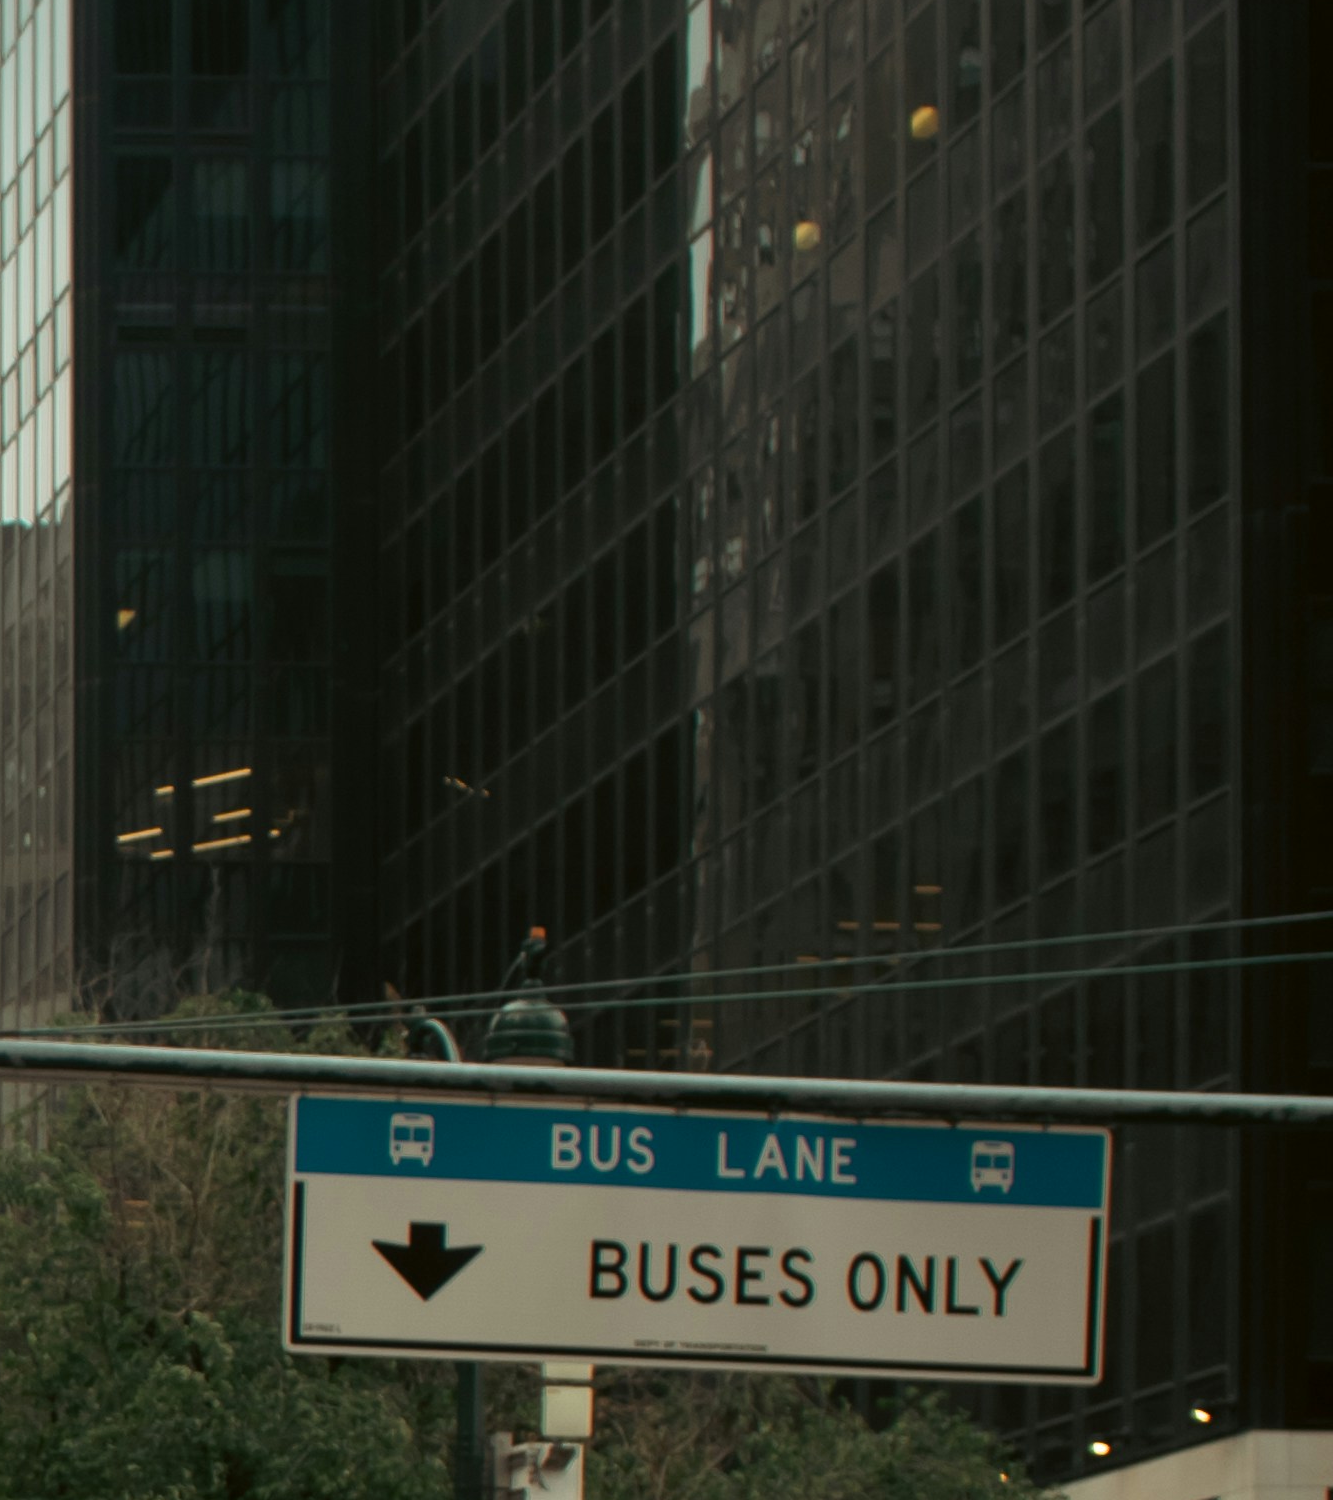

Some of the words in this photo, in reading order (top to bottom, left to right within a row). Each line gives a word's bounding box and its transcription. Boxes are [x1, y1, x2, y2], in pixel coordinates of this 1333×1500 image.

[550, 1122, 656, 1176] BUS
[717, 1130, 859, 1185] LANE
[588, 1238, 817, 1310] BUSES
[846, 1250, 1026, 1319] ONLY
